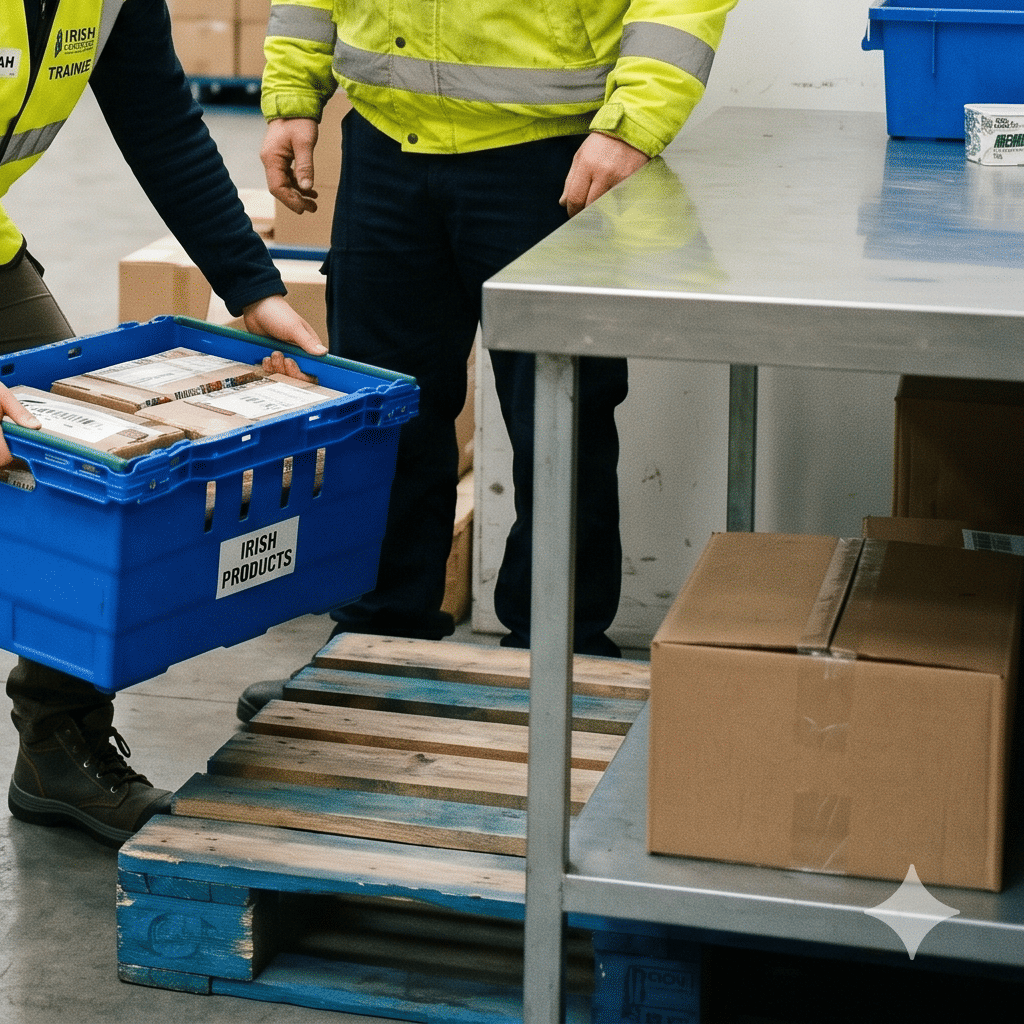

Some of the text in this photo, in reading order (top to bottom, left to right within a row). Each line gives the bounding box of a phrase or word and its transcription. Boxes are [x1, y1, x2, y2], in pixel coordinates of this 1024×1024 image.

[65, 27, 95, 43] IRISH
[241, 531, 277, 560] IRISH
[222, 549, 292, 589] PRODUCTS
